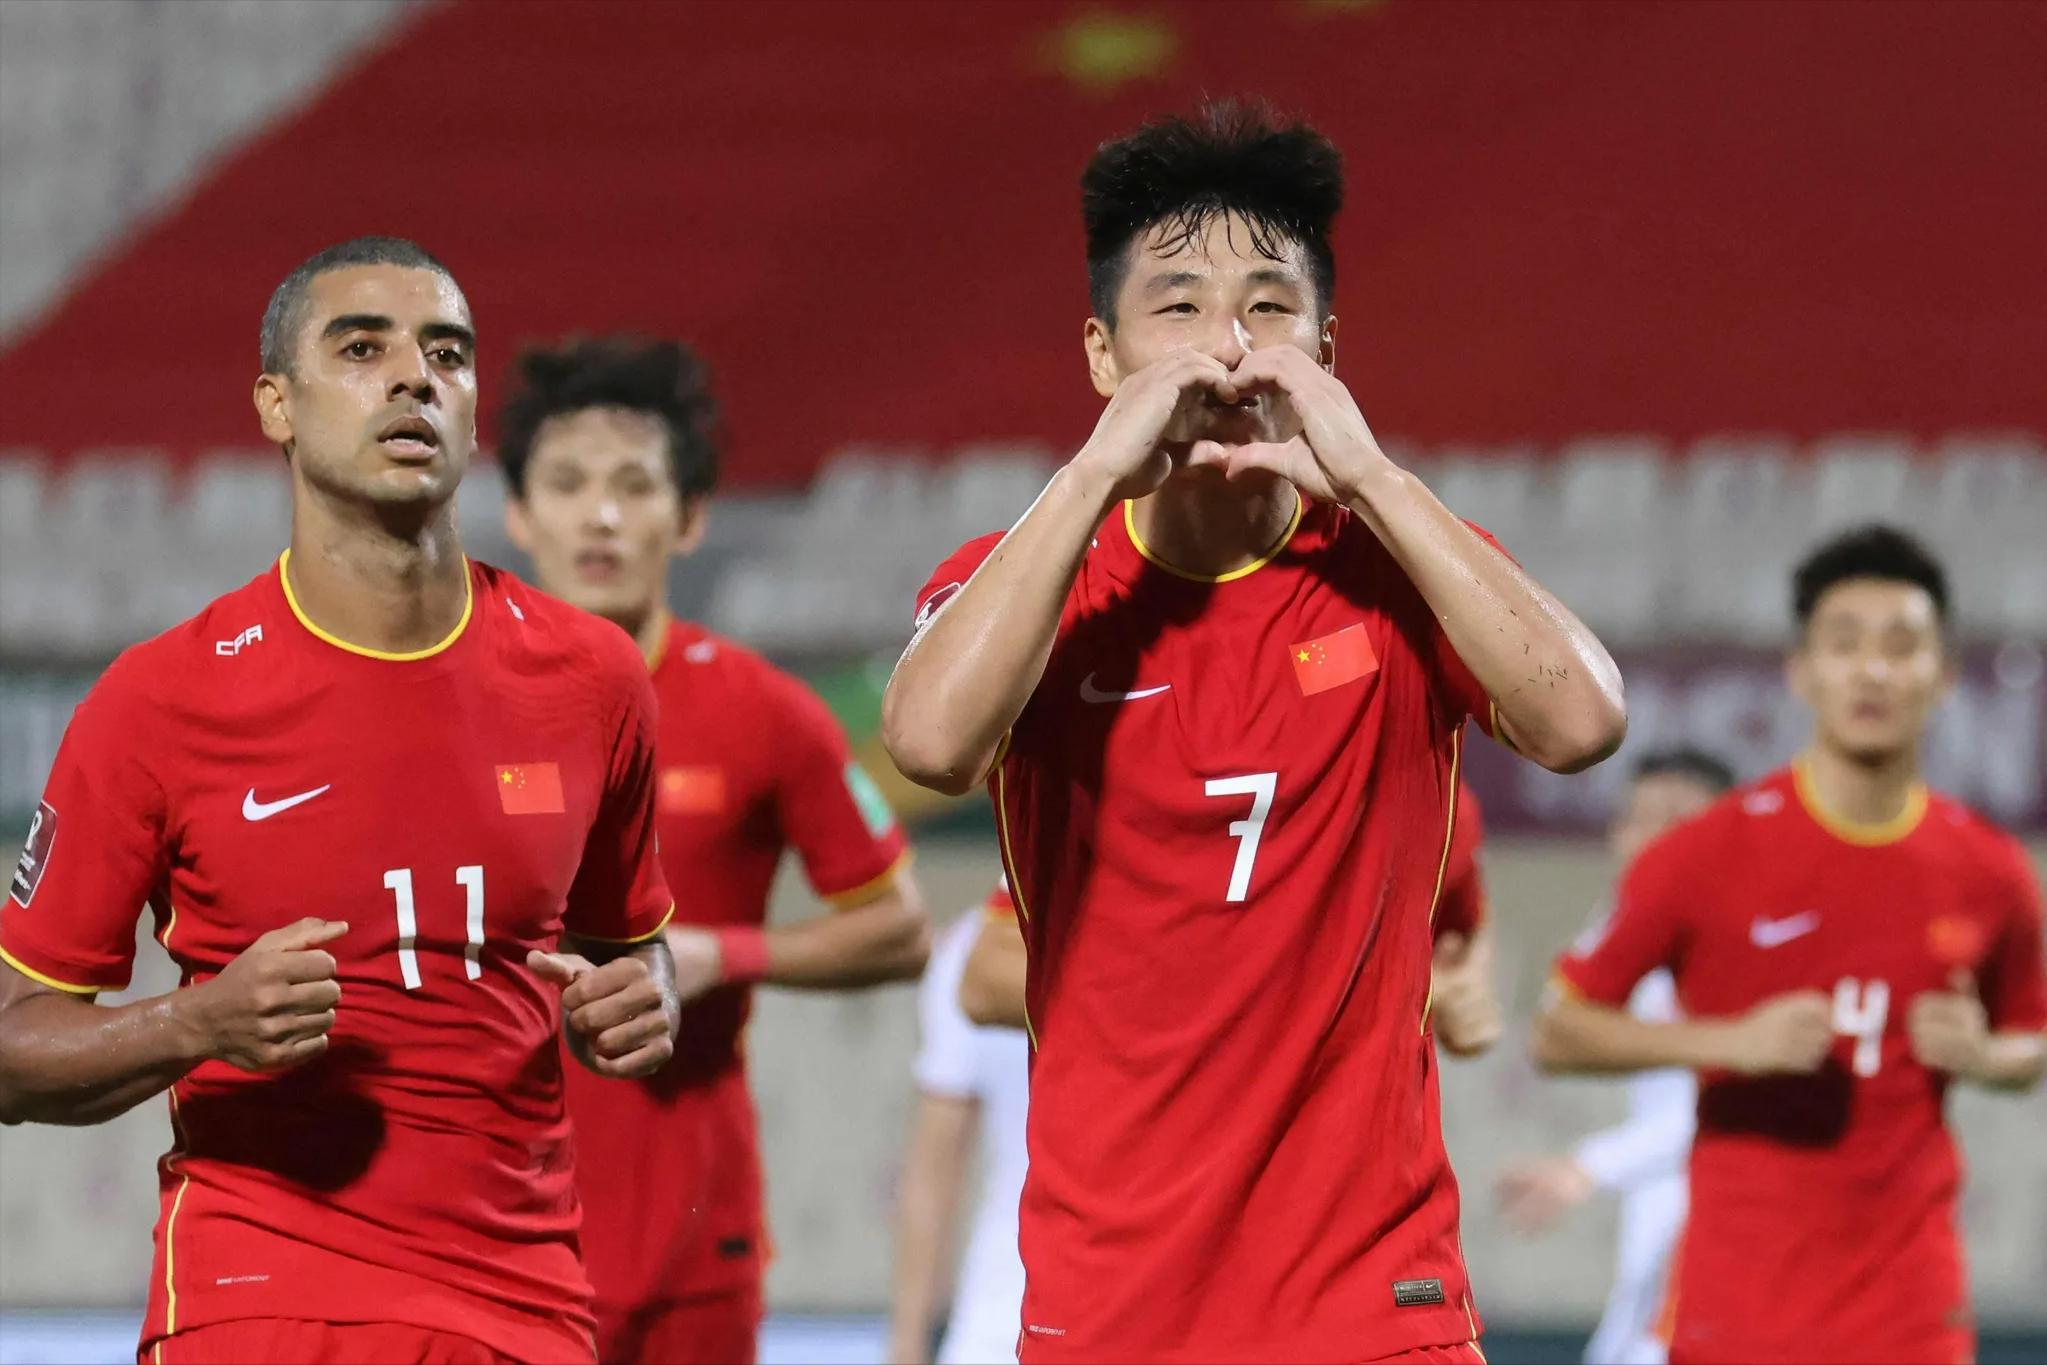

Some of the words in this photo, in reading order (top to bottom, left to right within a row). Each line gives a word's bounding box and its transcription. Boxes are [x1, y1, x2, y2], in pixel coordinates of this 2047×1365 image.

[216, 624, 263, 656] CFA
[1205, 772, 1277, 902] 7
[383, 865, 485, 990] 11
[1831, 976, 1889, 1078] 4
